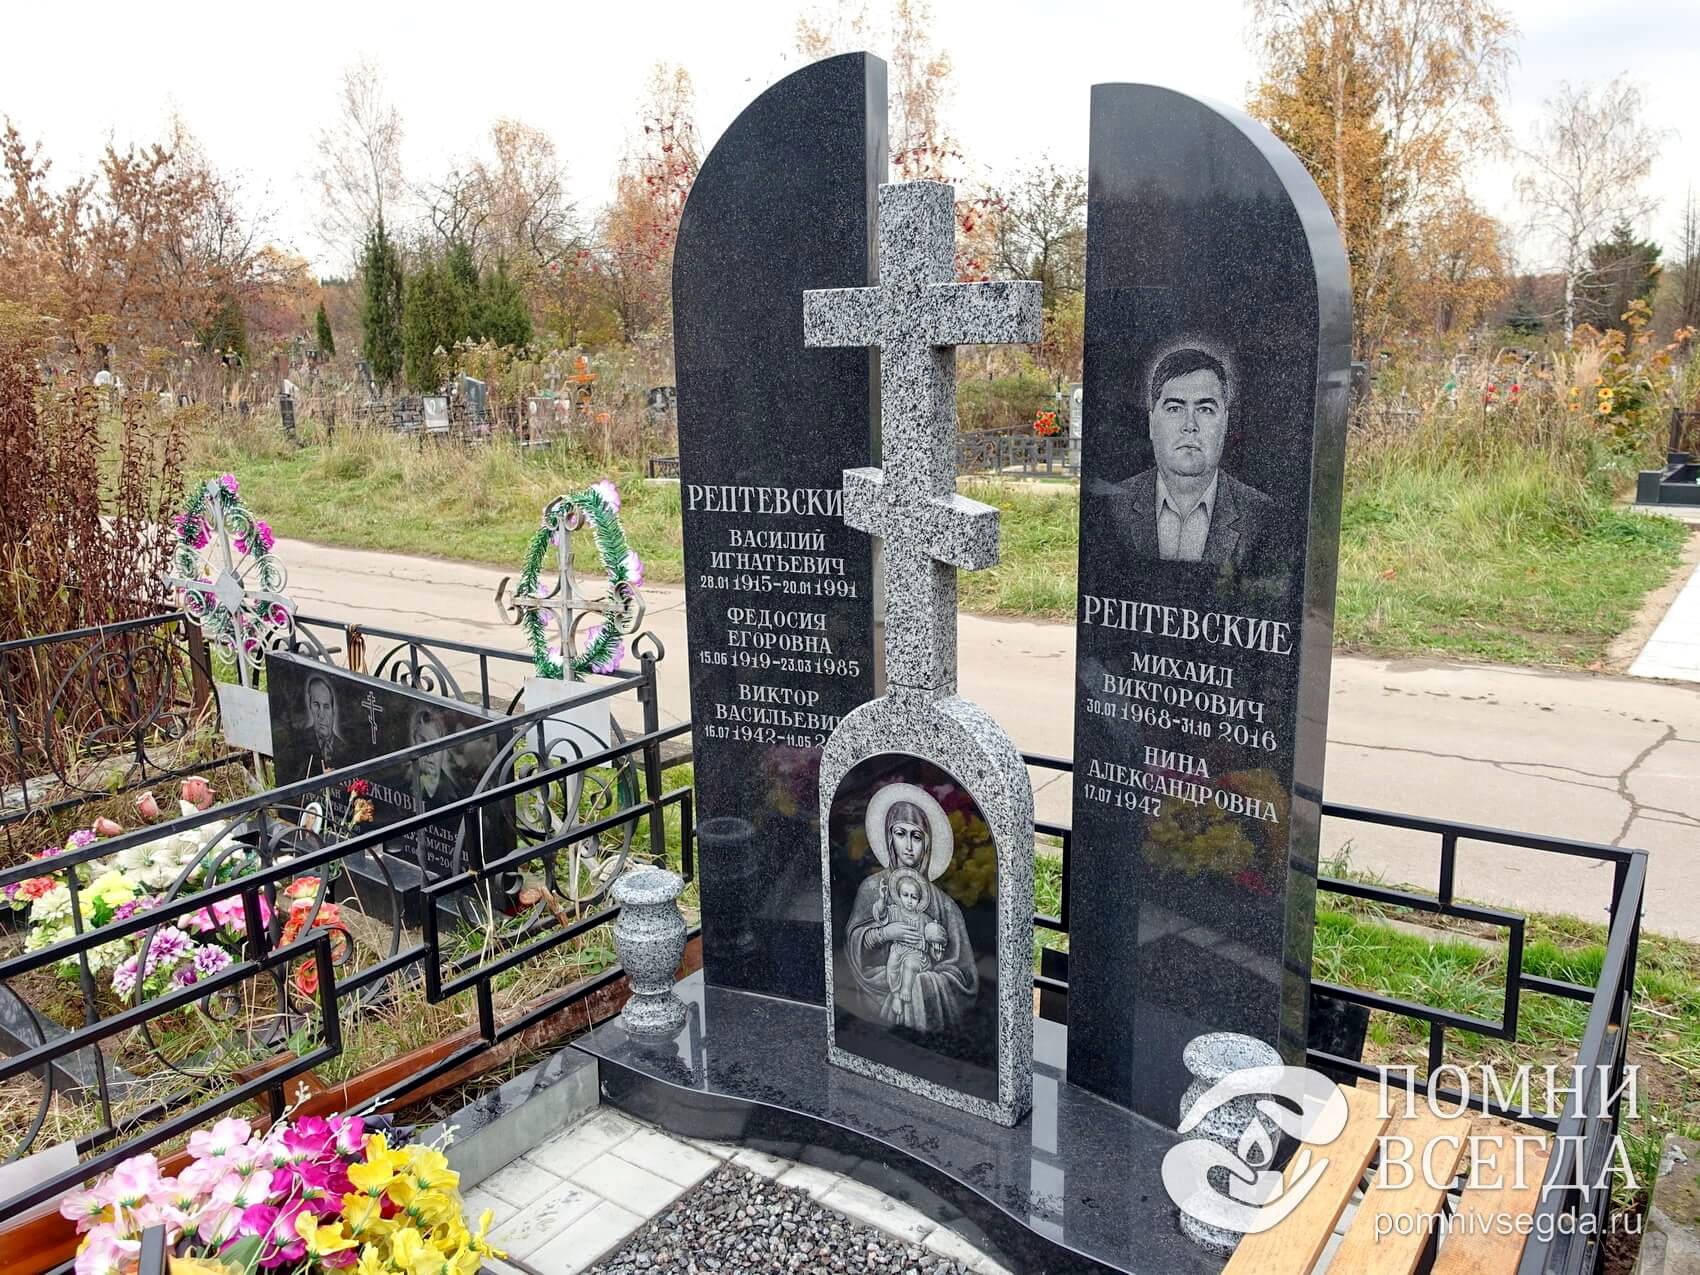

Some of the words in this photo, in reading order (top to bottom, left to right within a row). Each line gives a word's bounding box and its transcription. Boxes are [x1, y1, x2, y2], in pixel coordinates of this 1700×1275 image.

[685, 484, 843, 517] РЕПТЕВСКИ
[728, 528, 827, 551] ВАСИЛИЙ
[710, 551, 846, 576] ИГНАТЬЕВИЧ
[700, 575, 729, 590] 28.01
[814, 578, 858, 598] 1991
[727, 607, 828, 631] ФЕДОСИЯ
[1082, 594, 1294, 656] РЕПТЕВСКИЕ
[727, 629, 834, 655] ЕГОРОВНА
[699, 650, 728, 666] 15.06
[814, 657, 860, 678] 1985
[1131, 652, 1234, 689] МИХАИЛ
[738, 683, 820, 707] ВИКТОР
[1102, 674, 1265, 723] ВИКТОРОВИЧ
[1218, 721, 1277, 752] 2016
[1144, 745, 1211, 779] НИНА
[1083, 783, 1112, 804] 17.07
[1087, 759, 1281, 824] АЛЕКСАНДРОВНА
